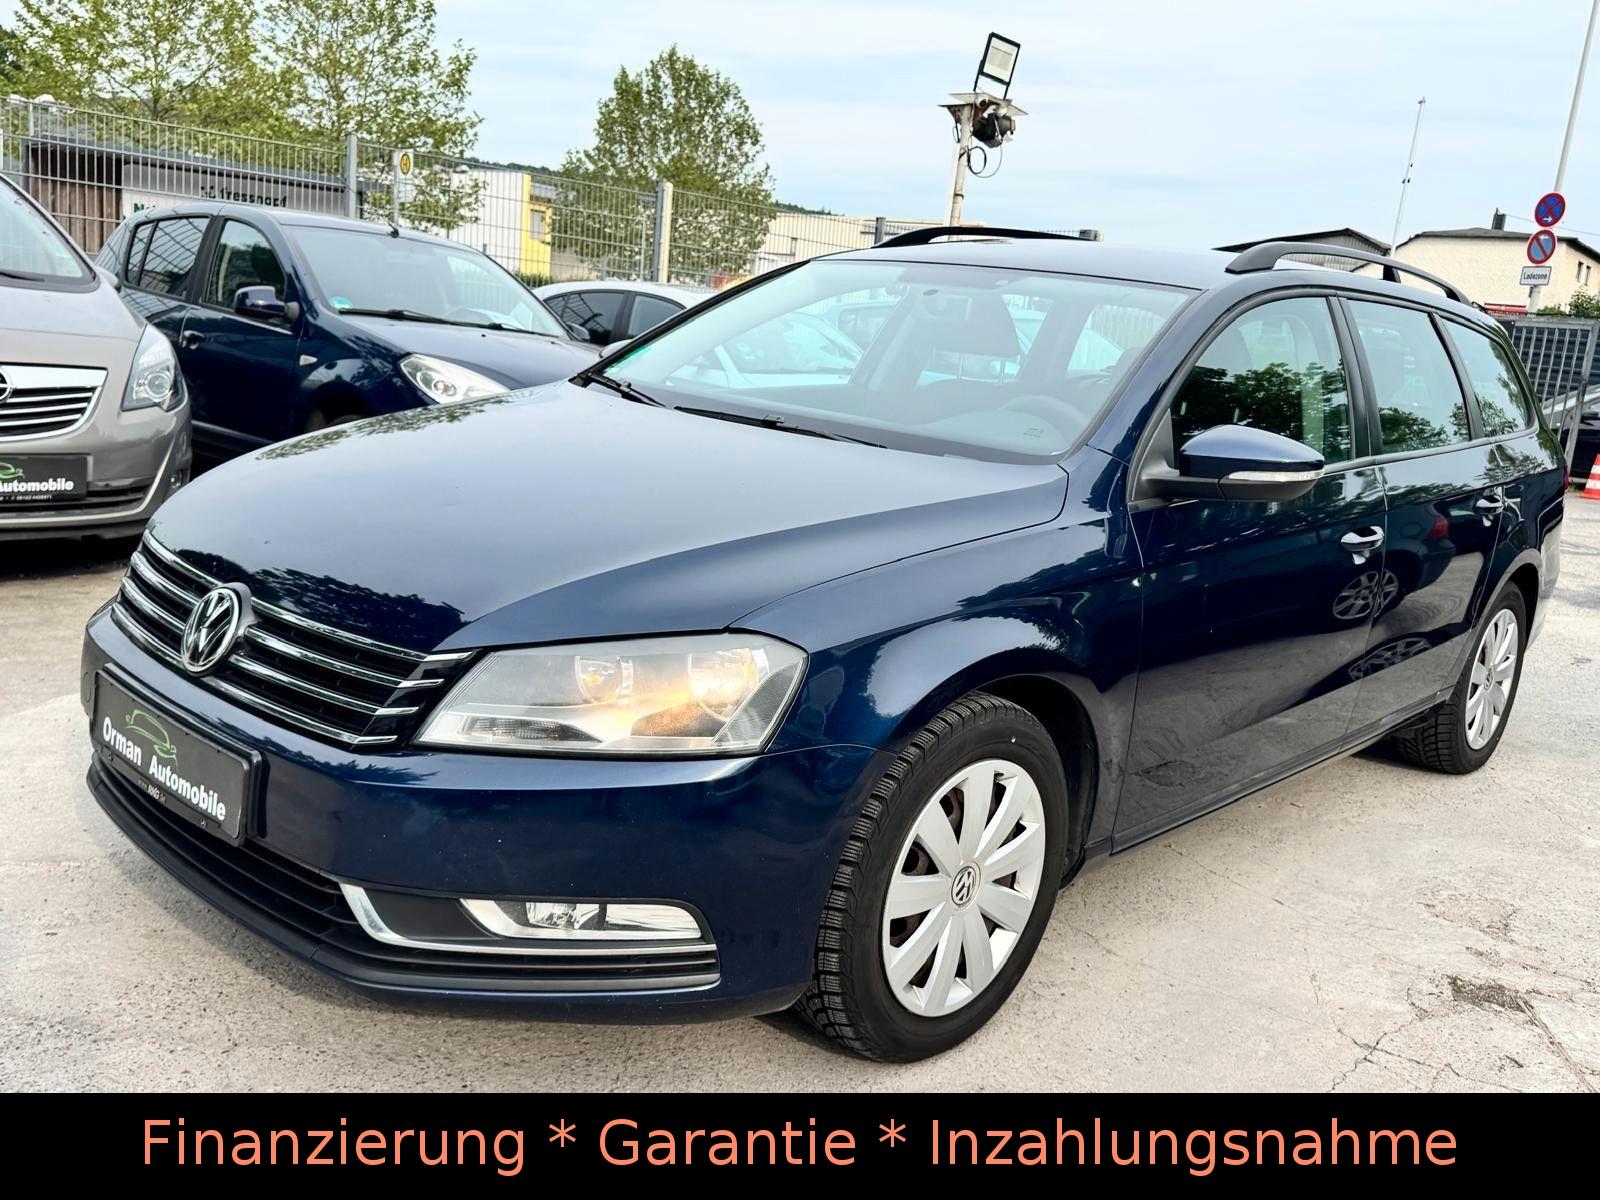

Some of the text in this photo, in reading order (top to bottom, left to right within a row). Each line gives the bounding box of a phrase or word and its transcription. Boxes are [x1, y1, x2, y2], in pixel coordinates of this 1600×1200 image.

[1523, 271, 1548, 281] Ladezone
[102, 716, 227, 821] Orman Automobile
